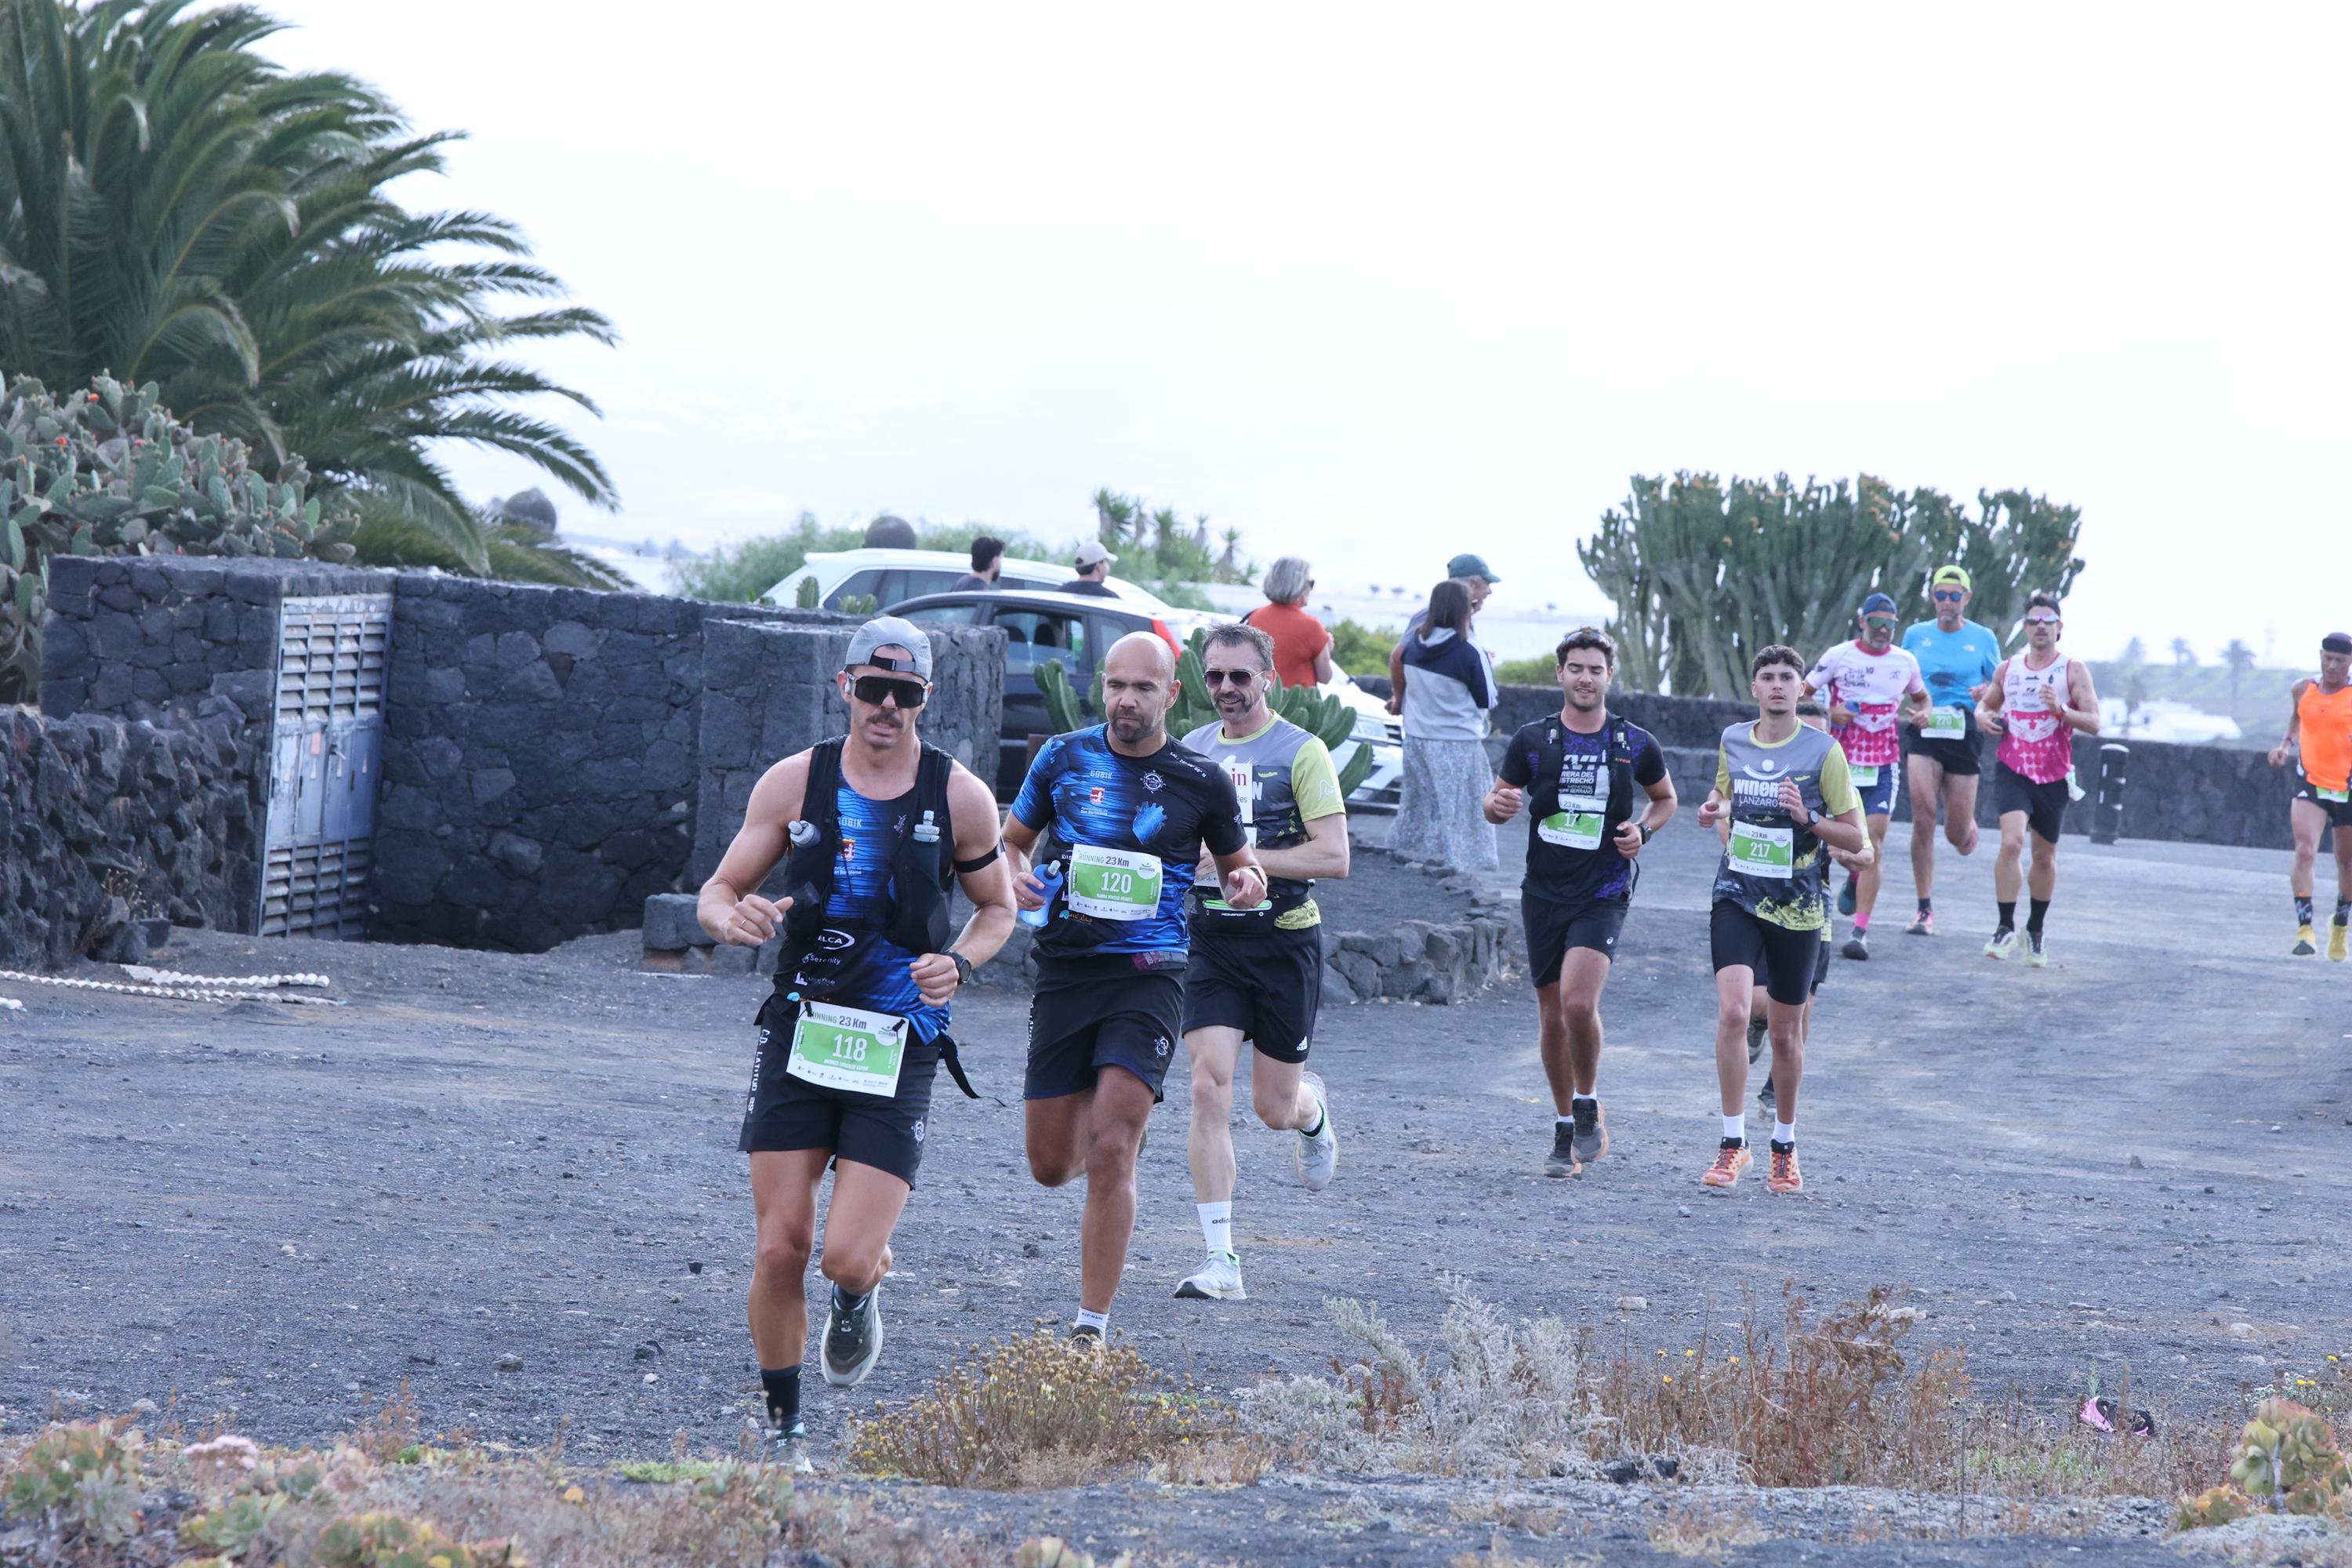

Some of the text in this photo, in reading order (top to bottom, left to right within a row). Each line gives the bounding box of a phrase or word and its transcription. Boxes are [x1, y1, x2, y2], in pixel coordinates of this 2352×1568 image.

[1090, 770, 1112, 779] GOBIK
[1739, 795, 1788, 808] LANZARO
[1750, 842, 1770, 858] 217
[1078, 853, 1129, 867] RUNNING 23 Km
[1101, 871, 1132, 894] 120
[811, 1011, 867, 1029] UNNING 23 Km
[832, 1033, 868, 1062] 118
[751, 1051, 763, 1091] LATITUD
